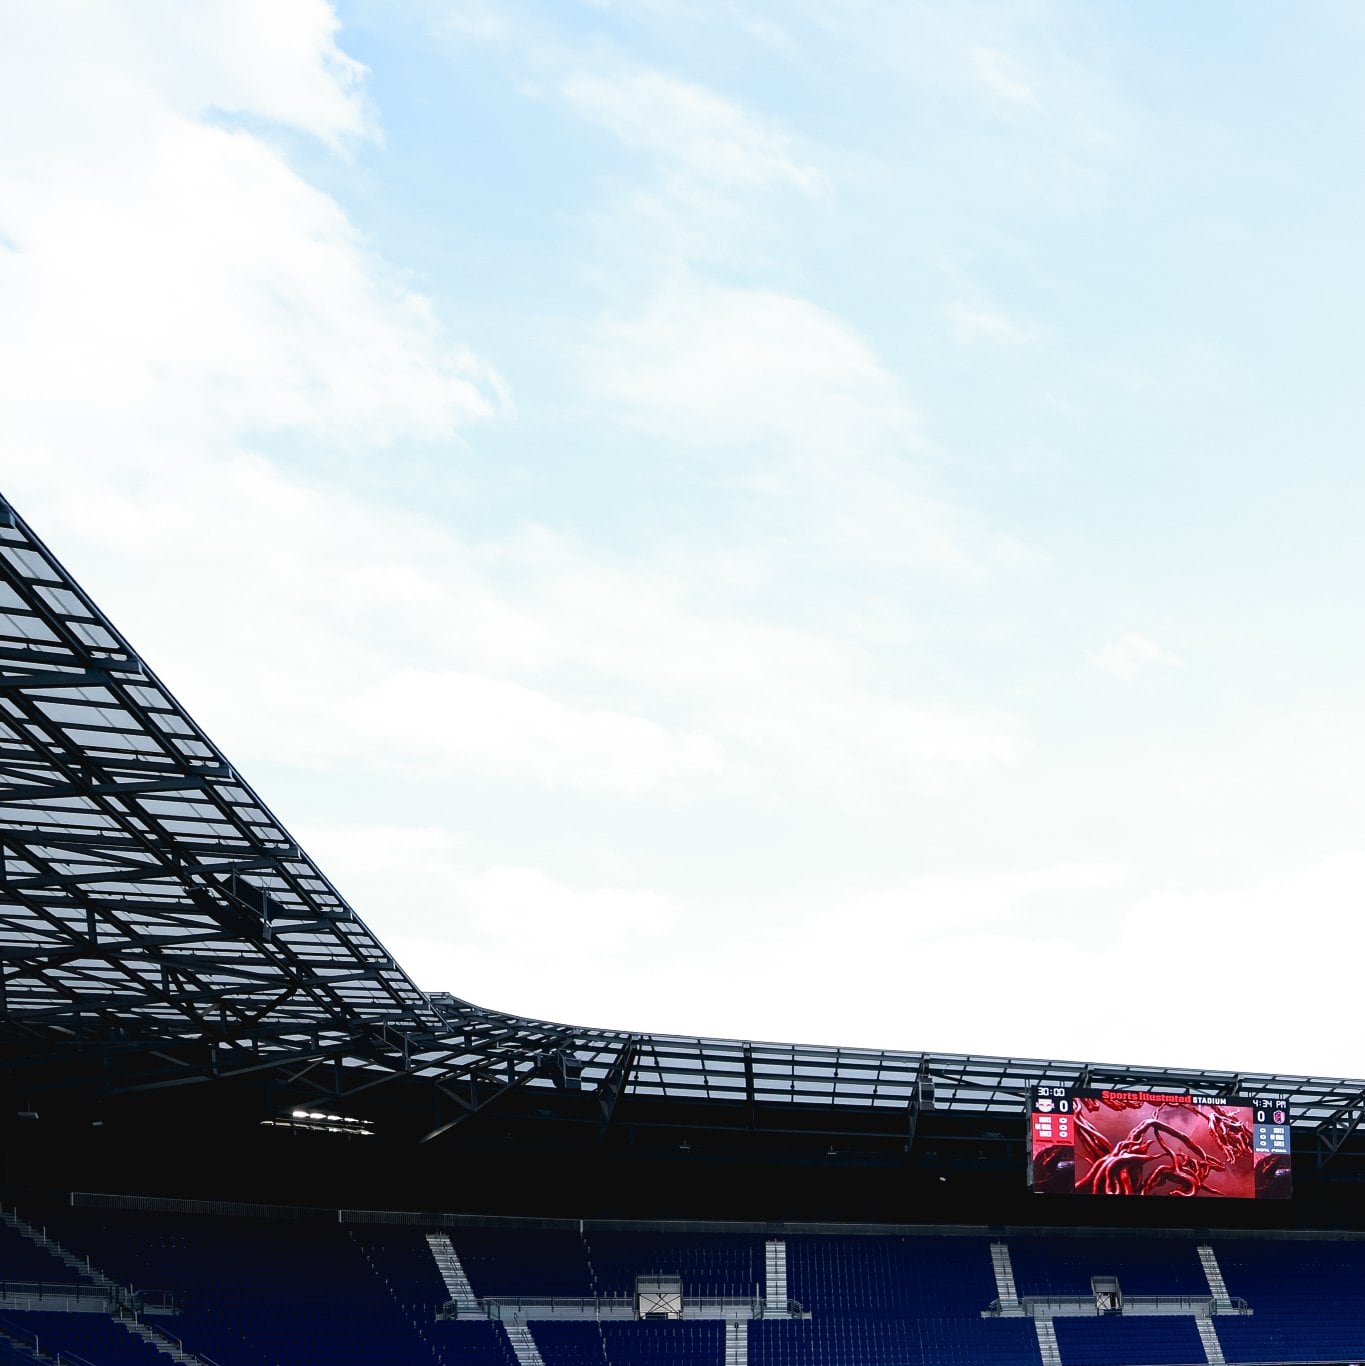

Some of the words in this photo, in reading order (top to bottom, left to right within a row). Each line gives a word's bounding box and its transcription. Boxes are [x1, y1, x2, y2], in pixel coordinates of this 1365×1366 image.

[1037, 1087, 1065, 1097] 30:00
[1101, 1090, 1138, 1100] Sports
[1138, 1091, 1191, 1104] Illustrated
[1192, 1096, 1227, 1105] STADIUM
[1059, 1100, 1069, 1113] 0
[1252, 1100, 1272, 1108] 4:34
[1275, 1100, 1287, 1109] PM
[1256, 1110, 1265, 1122] 0
